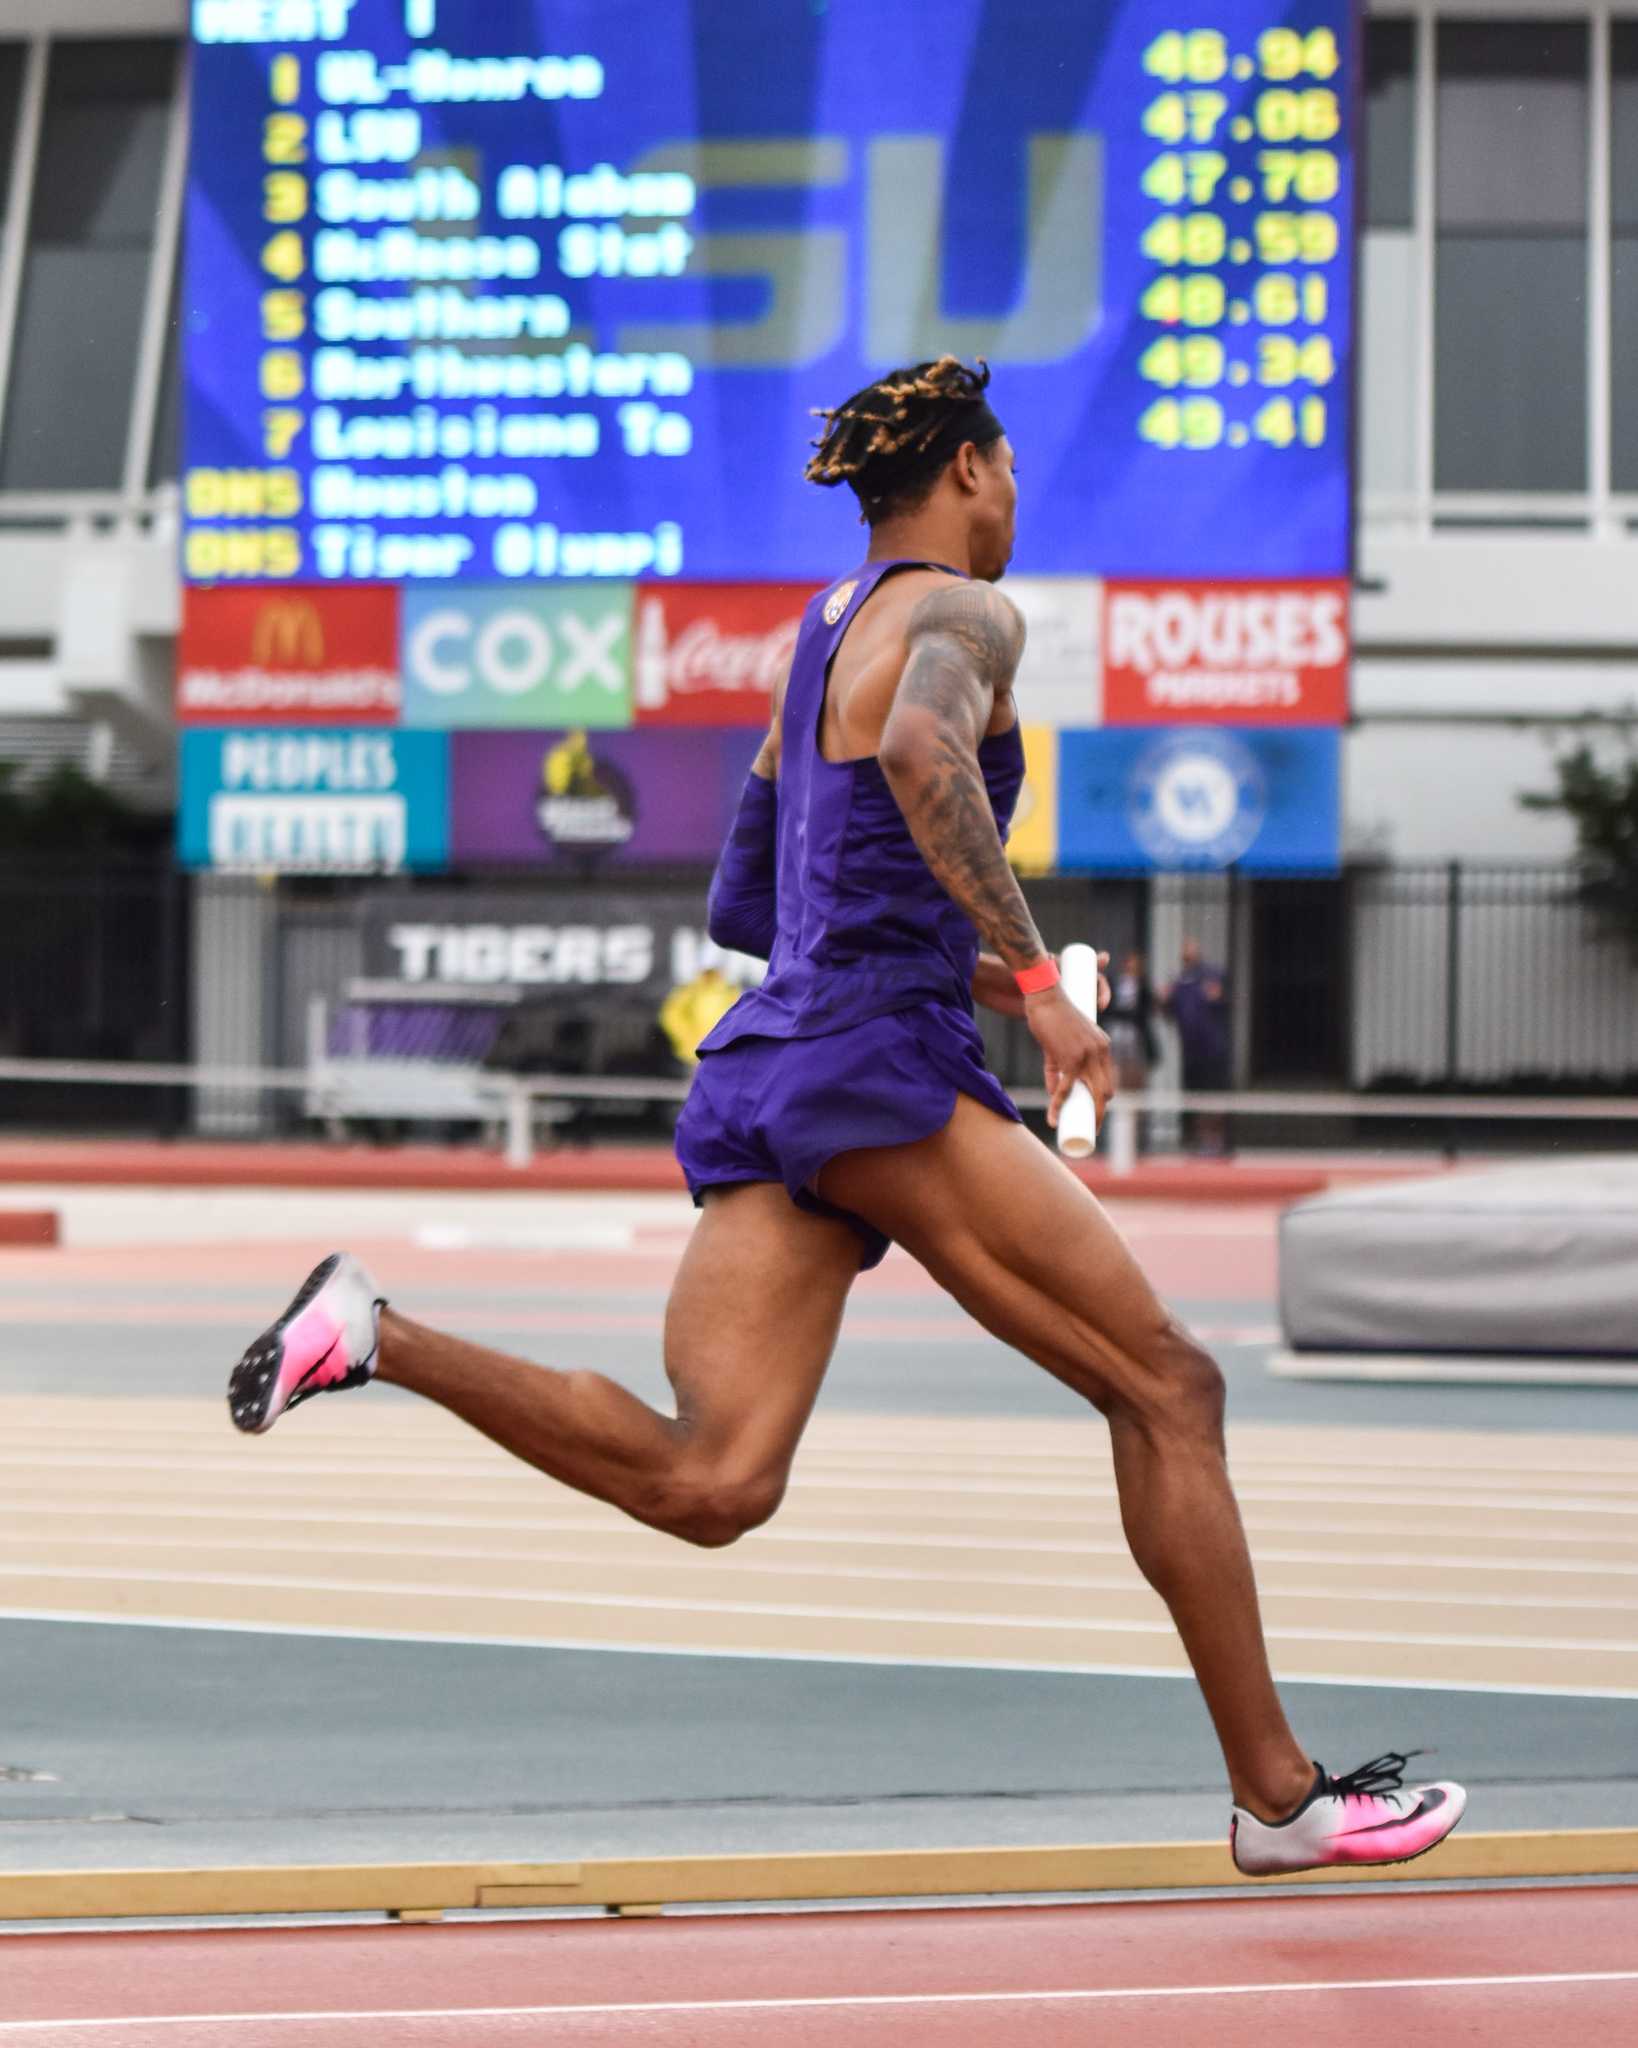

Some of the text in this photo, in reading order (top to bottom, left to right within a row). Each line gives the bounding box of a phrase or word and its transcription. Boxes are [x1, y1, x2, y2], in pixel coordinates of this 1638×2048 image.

[272, 55, 299, 104] 1
[1143, 29, 1337, 83] 46.94
[265, 89, 1338, 164] 2 LSU 47.06
[266, 172, 306, 222] 3
[316, 166, 480, 223] South
[263, 231, 303, 281] 4
[261, 290, 304, 341] 5
[315, 285, 570, 341] Southern
[260, 349, 303, 399] 6
[312, 343, 695, 400] Northwestern
[265, 408, 303, 459] 7
[312, 404, 599, 460] Louisiana
[312, 464, 537, 519] Houston
[410, 609, 627, 694] COX
[1108, 591, 1346, 674] ROUSES
[222, 733, 397, 790] PEOPLES
[390, 923, 654, 983] TIGERS
